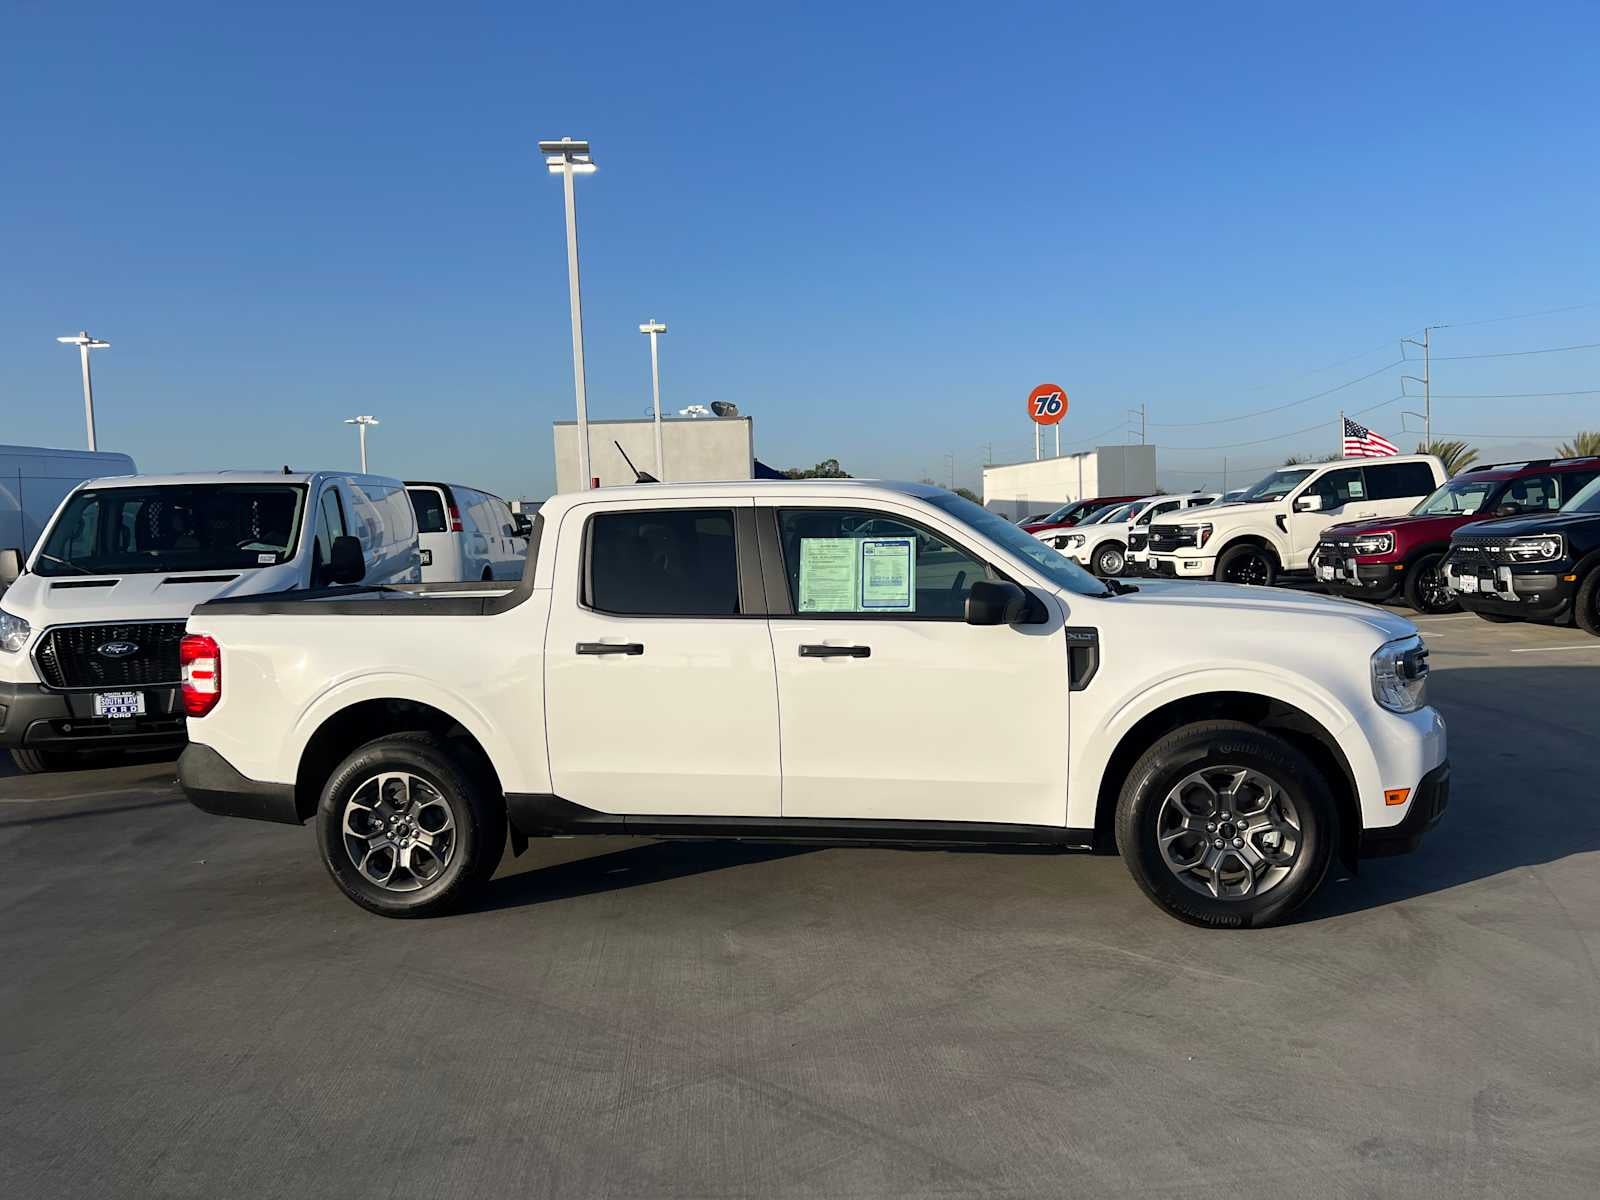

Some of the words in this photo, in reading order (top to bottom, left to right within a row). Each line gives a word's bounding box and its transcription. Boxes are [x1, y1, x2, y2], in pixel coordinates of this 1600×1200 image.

[1034, 391, 1063, 416] 76
[1067, 632, 1096, 640] XLT
[101, 696, 122, 706] SOUTH
[123, 695, 138, 705] BAY
[102, 706, 137, 714] FORD
